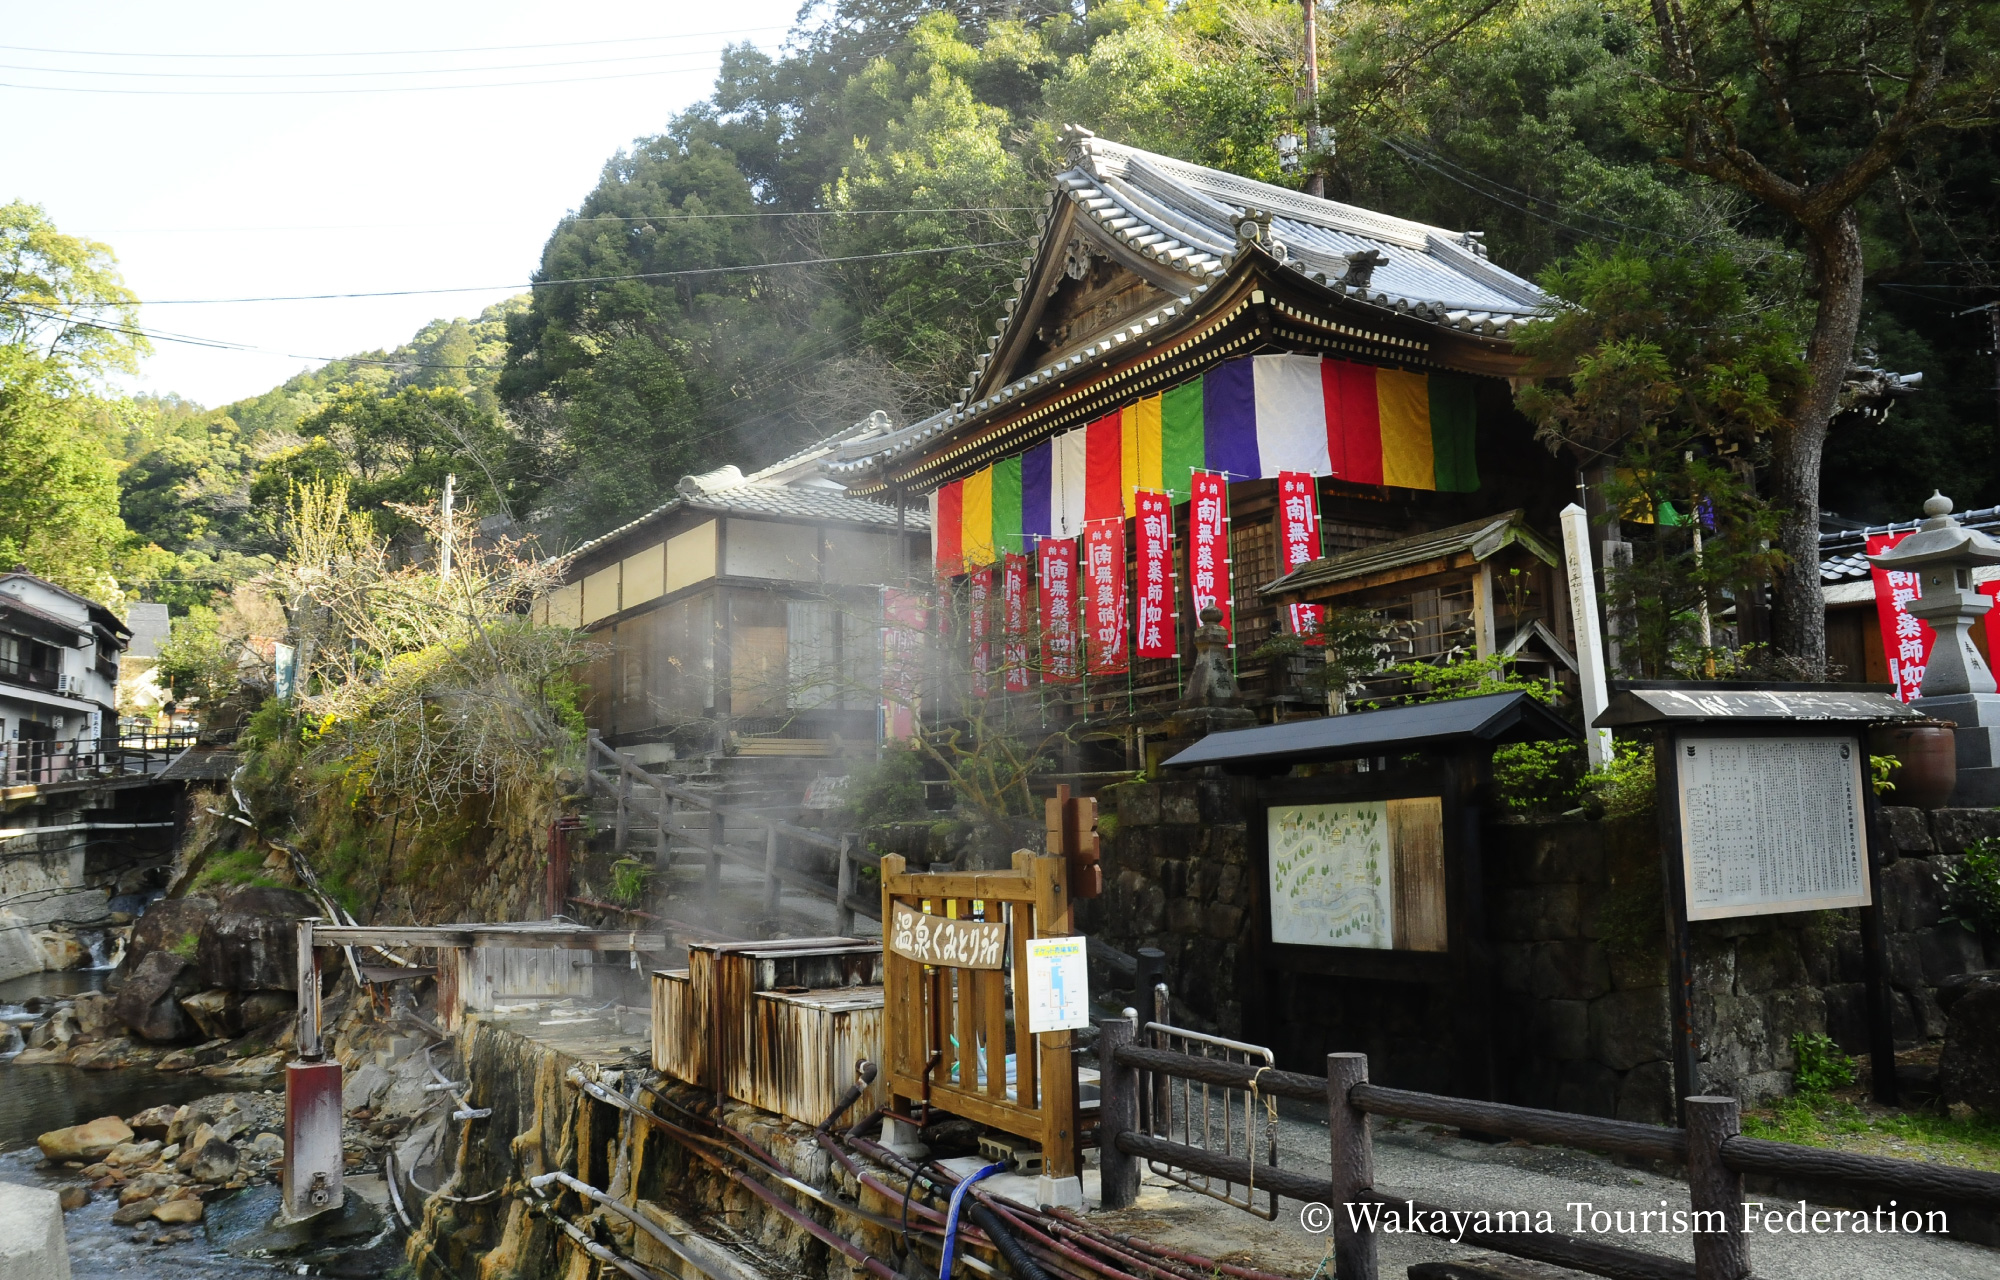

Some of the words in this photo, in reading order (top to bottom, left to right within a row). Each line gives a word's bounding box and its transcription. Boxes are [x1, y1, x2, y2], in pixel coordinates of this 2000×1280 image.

[1199, 481, 1218, 495] 奉納
[1284, 480, 1305, 493] 奉納
[1142, 499, 1163, 512] 奉納
[1142, 514, 1164, 649] 南無薬師如来
[895, 911, 1000, 966] 温泉くみとり所
